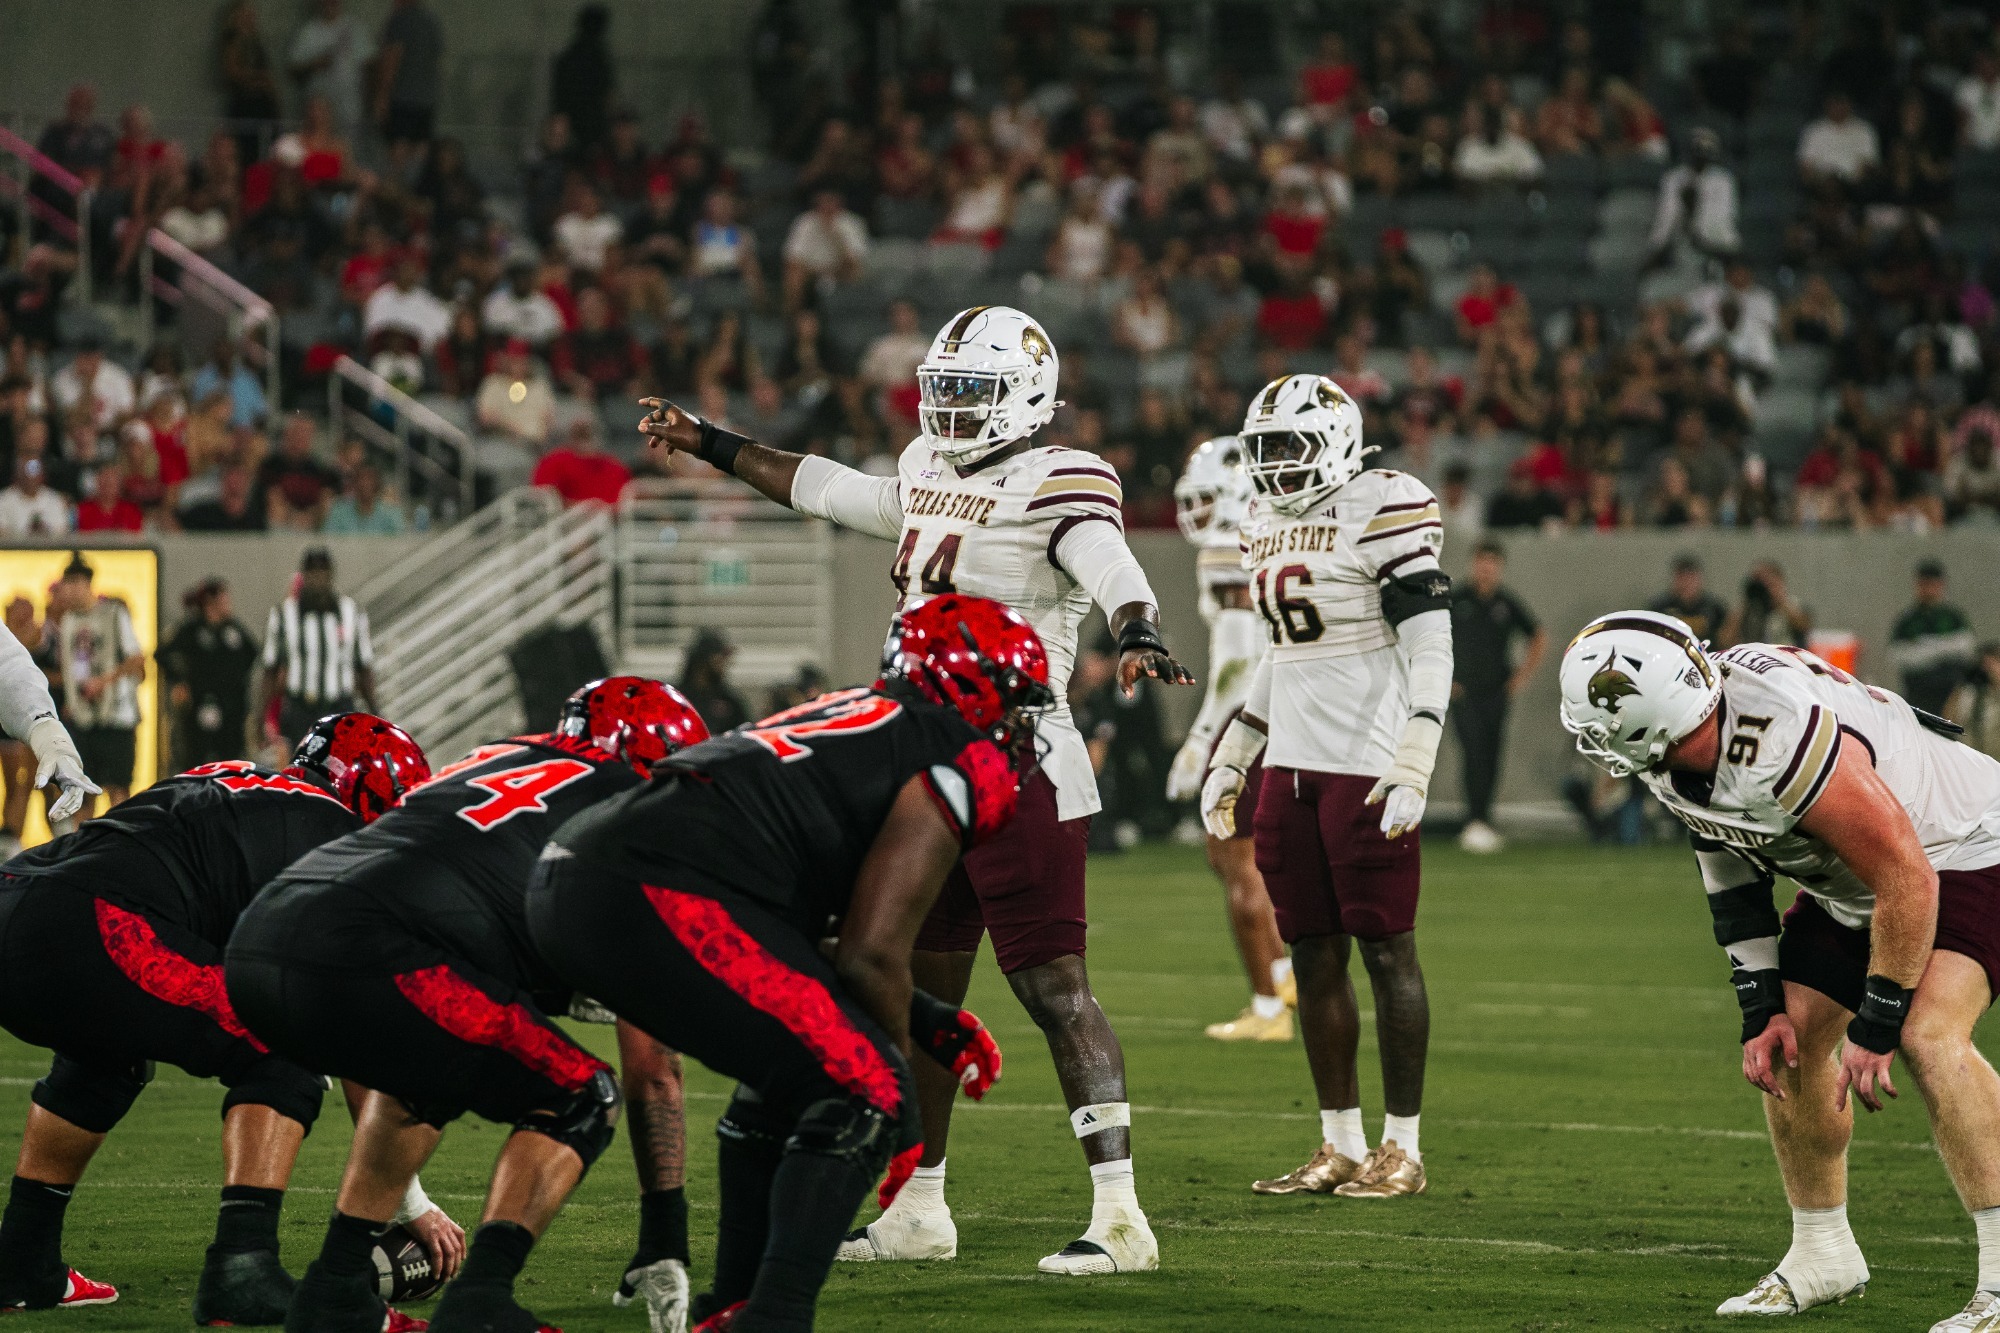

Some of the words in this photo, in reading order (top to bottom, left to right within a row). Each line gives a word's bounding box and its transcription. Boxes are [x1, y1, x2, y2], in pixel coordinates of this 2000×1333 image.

[904, 487, 947, 518] TEXAS
[946, 492, 997, 527] STATE
[1288, 525, 1338, 552] STATE
[890, 527, 963, 612] 44
[1256, 563, 1326, 645] 16
[1727, 714, 1774, 767] 91
[1866, 991, 1898, 1006] MUELLER
